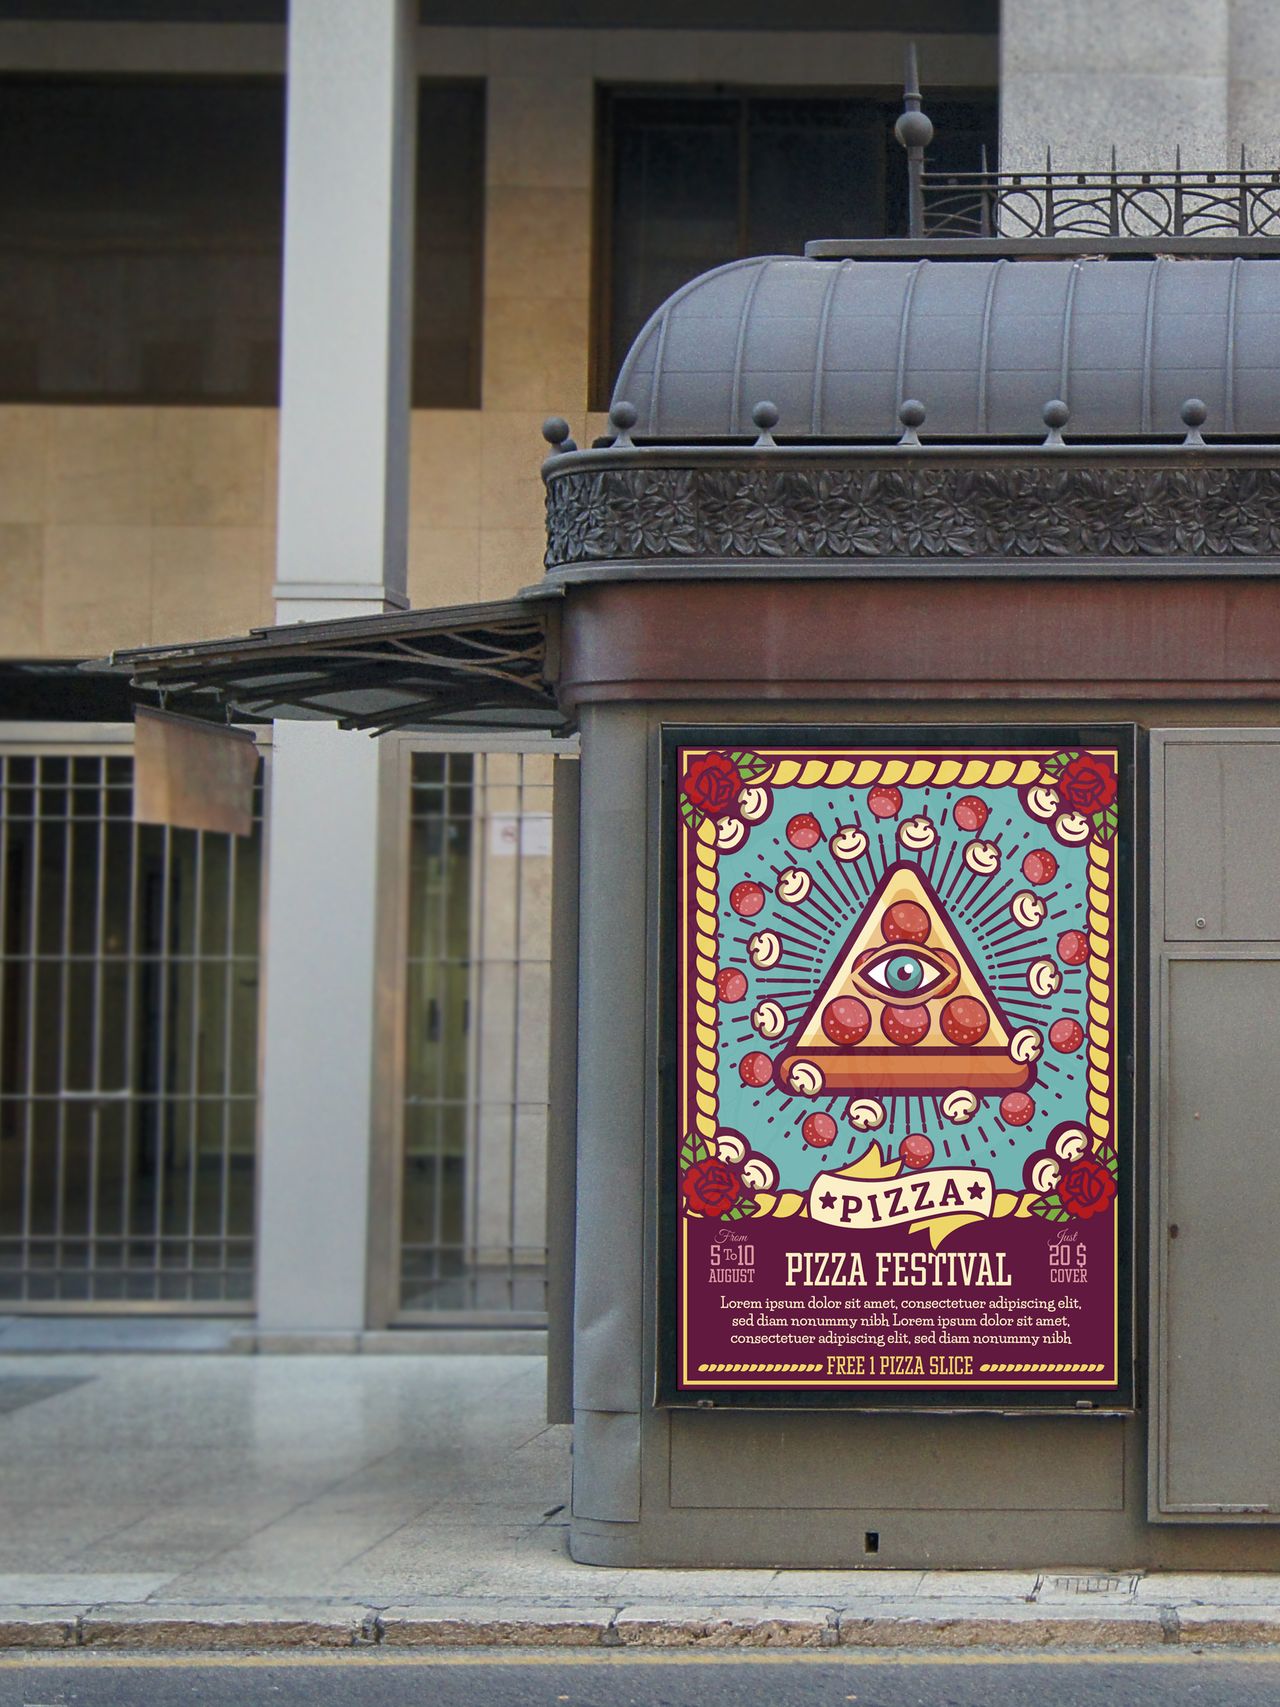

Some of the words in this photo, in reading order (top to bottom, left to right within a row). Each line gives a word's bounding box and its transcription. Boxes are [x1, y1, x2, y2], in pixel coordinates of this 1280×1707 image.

[839, 1178, 965, 1223] PIZZA
[714, 1228, 749, 1243] From
[1048, 1227, 1079, 1246] Just
[710, 1244, 721, 1266] 5
[738, 1244, 755, 1266] 10
[1049, 1244, 1070, 1266] 20
[1076, 1242, 1087, 1268] $
[708, 1268, 756, 1283] AUGUST
[785, 1252, 868, 1287] PIZZA
[875, 1252, 1012, 1287] FESTIVAL
[1050, 1268, 1088, 1283] COVER
[720, 1296, 763, 1309] Lorem
[764, 1296, 806, 1312] ipsum
[808, 1296, 841, 1309] dolor
[844, 1297, 862, 1309] sit
[864, 1298, 898, 1311] amet,
[900, 1298, 986, 1310] consectetuer
[988, 1296, 1056, 1312] adipiscing
[1058, 1296, 1082, 1311] elit,
[732, 1313, 754, 1327] sed
[757, 1313, 788, 1327] diam
[791, 1316, 857, 1329] nonummy
[860, 1313, 890, 1327] nibh
[892, 1313, 935, 1327] Lorem
[937, 1313, 978, 1329] ipsum
[980, 1313, 1014, 1327] dolor
[1016, 1315, 1033, 1327] sit
[1036, 1315, 1071, 1328] amet,
[730, 1332, 816, 1345] consectetuer
[818, 1330, 885, 1347] adipiscing
[887, 1330, 912, 1346] elit,
[914, 1330, 936, 1345] sed
[939, 1330, 971, 1345] diam
[973, 1333, 1040, 1347] nonummy
[1042, 1330, 1073, 1345] nibh
[826, 1355, 865, 1375] FREE
[869, 1355, 876, 1375] 1
[879, 1355, 925, 1375] PIZZA
[929, 1355, 973, 1375] SLICE
